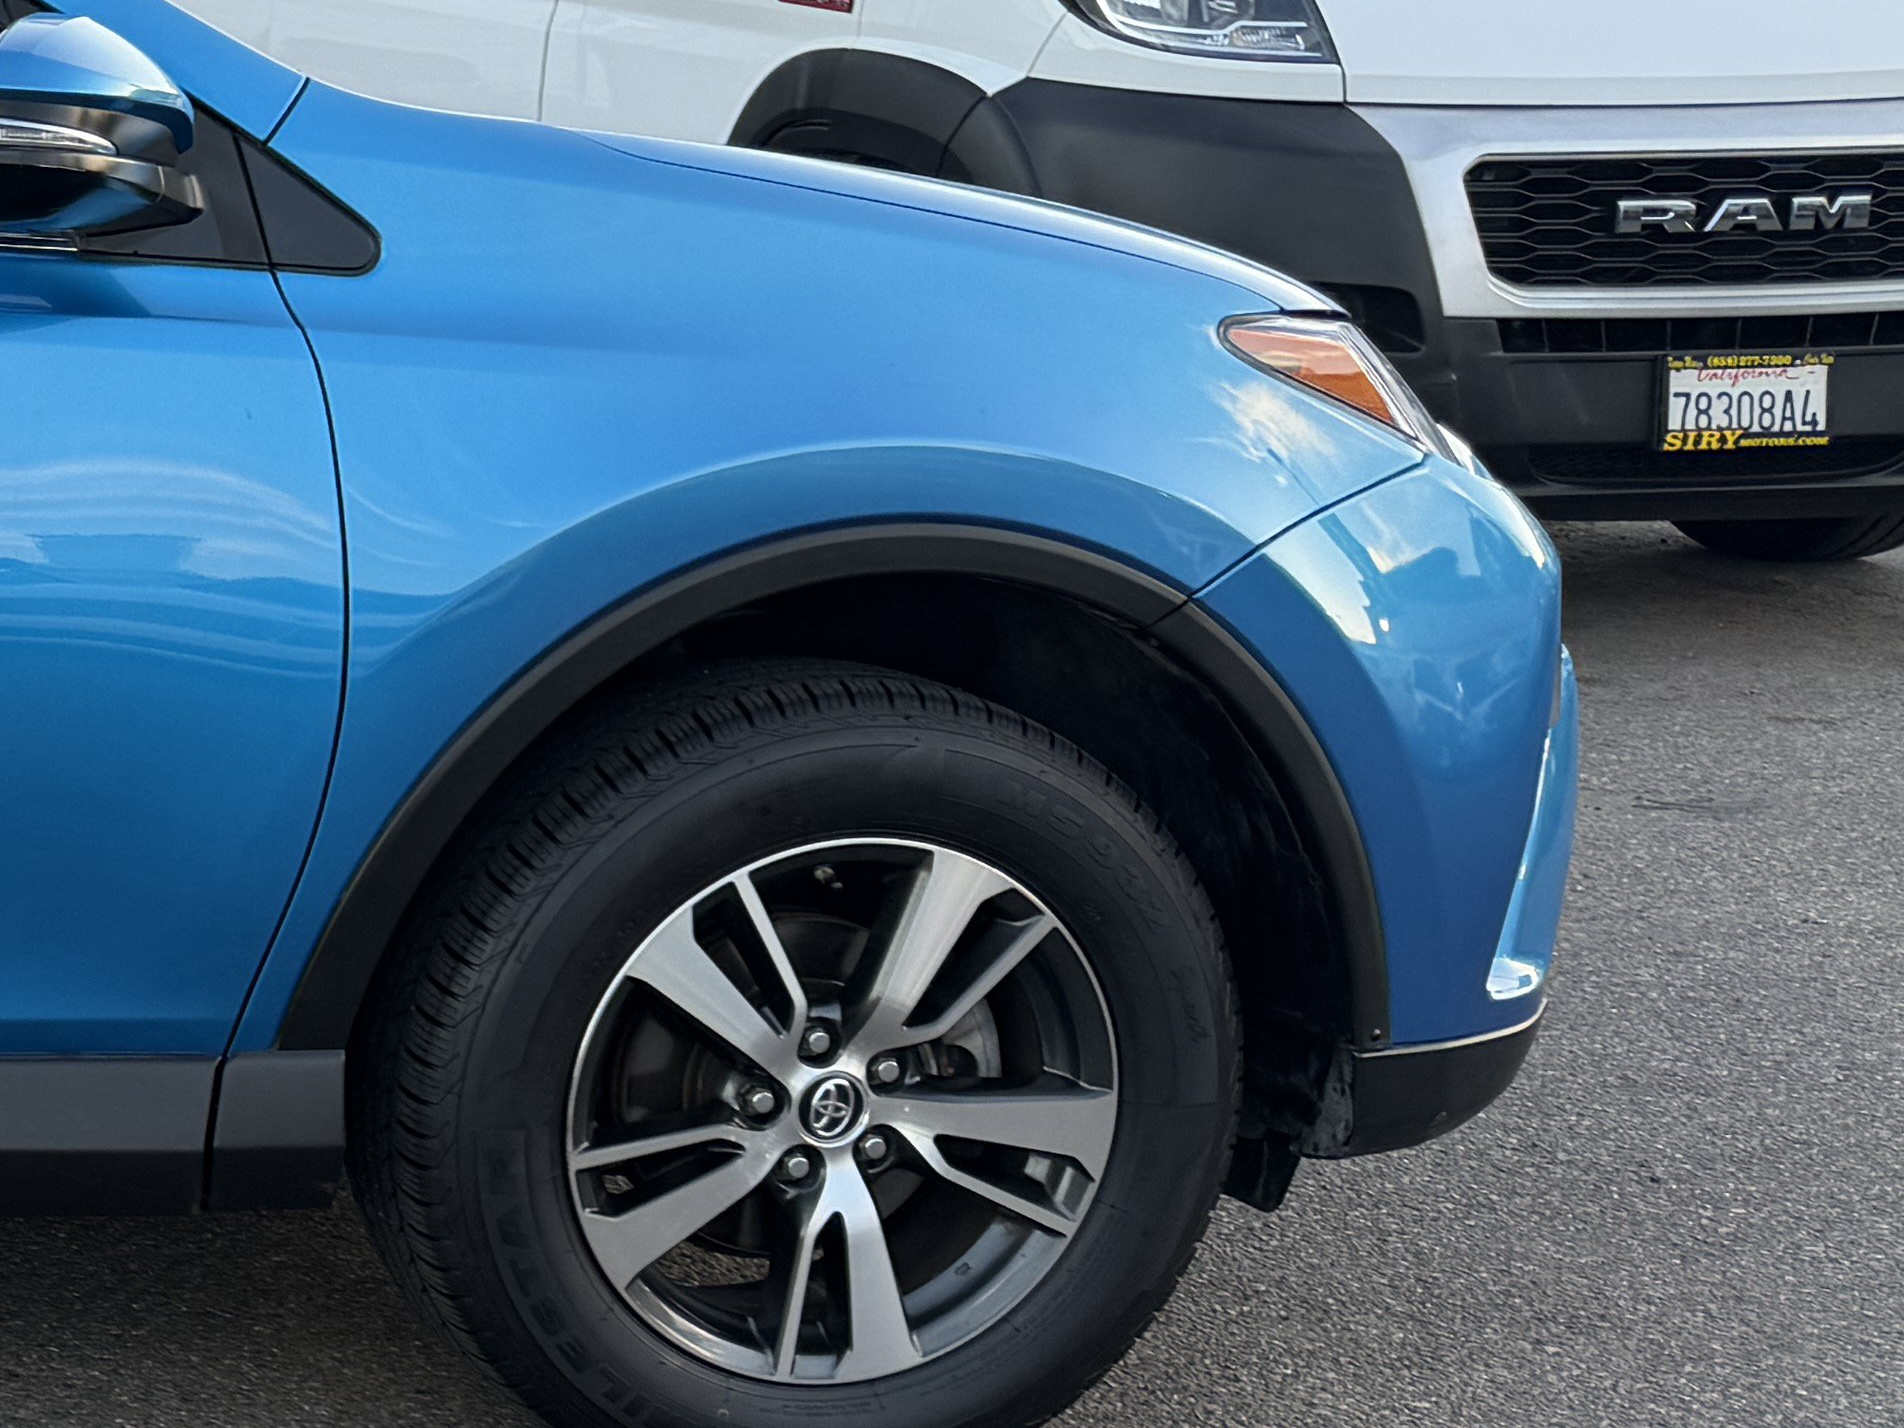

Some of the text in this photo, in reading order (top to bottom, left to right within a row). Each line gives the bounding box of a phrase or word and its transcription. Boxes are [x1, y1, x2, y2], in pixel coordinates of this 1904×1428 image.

[1615, 193, 1873, 233] RAM
[1696, 367, 1800, 387] California
[1672, 389, 1820, 432] 78308A4
[1663, 429, 1743, 451] SIRY
